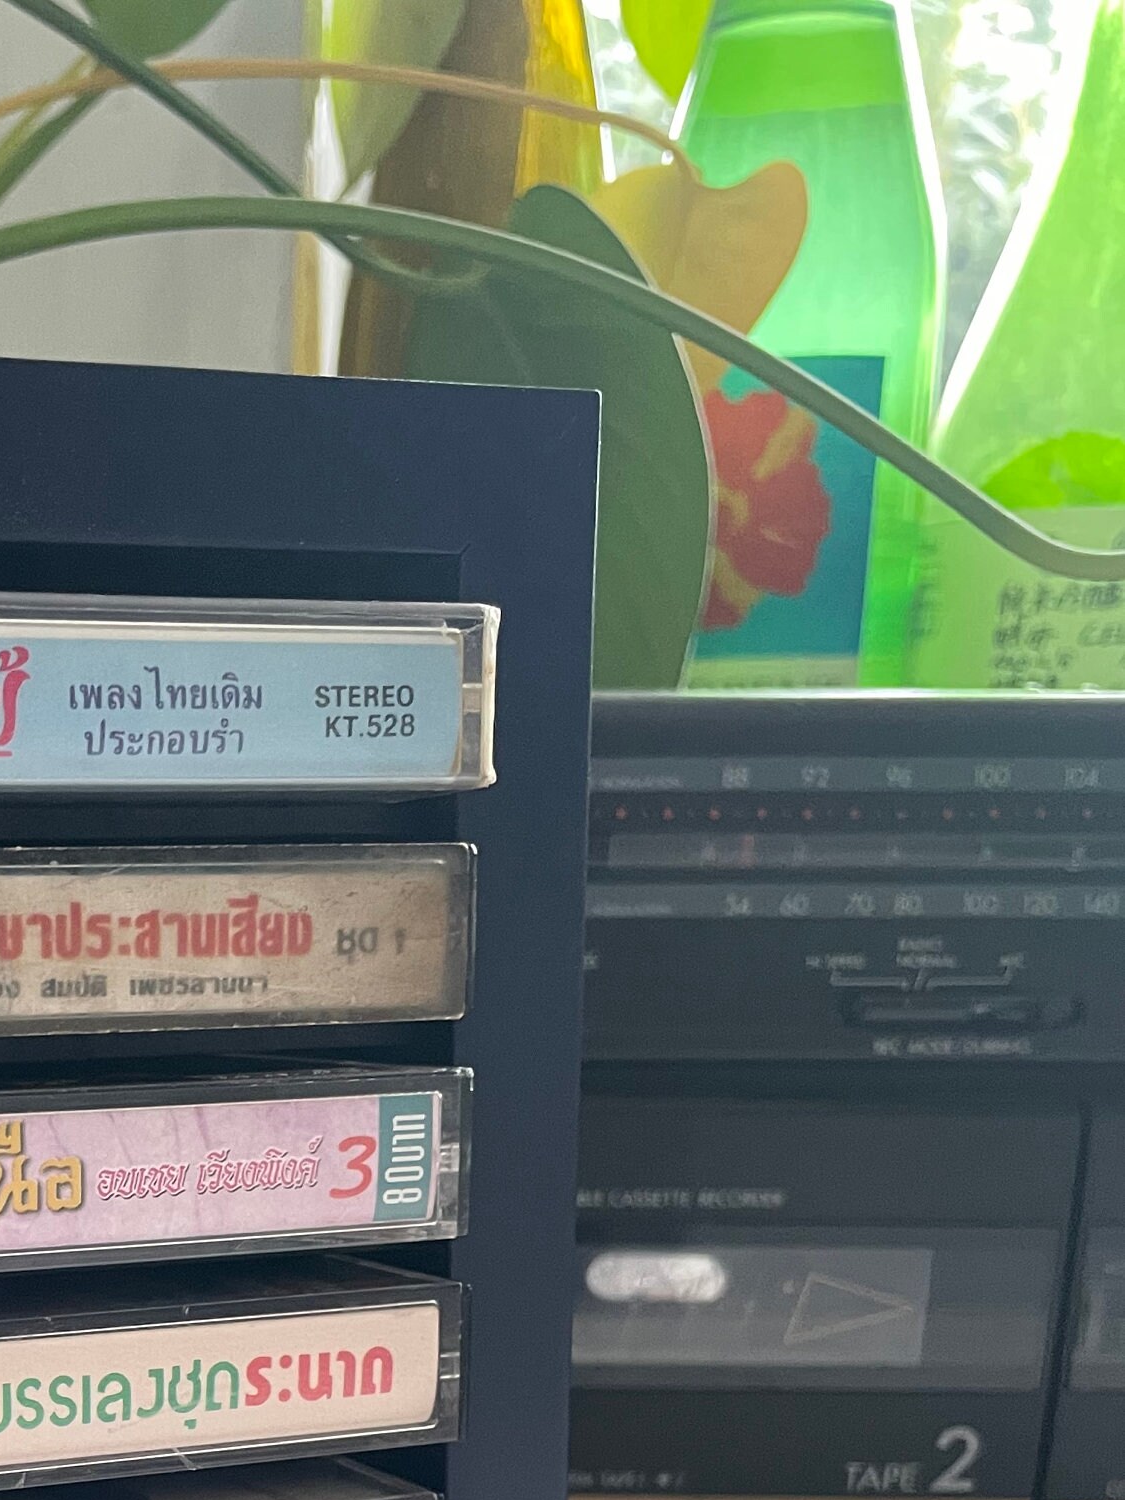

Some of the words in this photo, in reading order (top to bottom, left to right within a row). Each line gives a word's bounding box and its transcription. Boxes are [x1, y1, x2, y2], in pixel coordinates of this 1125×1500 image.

[315, 685, 415, 708] STEREO
[84, 718, 244, 757] ประกอบรำ
[325, 713, 416, 739] KT.528
[328, 1135, 376, 1198] 3
[845, 1461, 923, 1493] TAPE
[929, 1424, 980, 1495] 2
